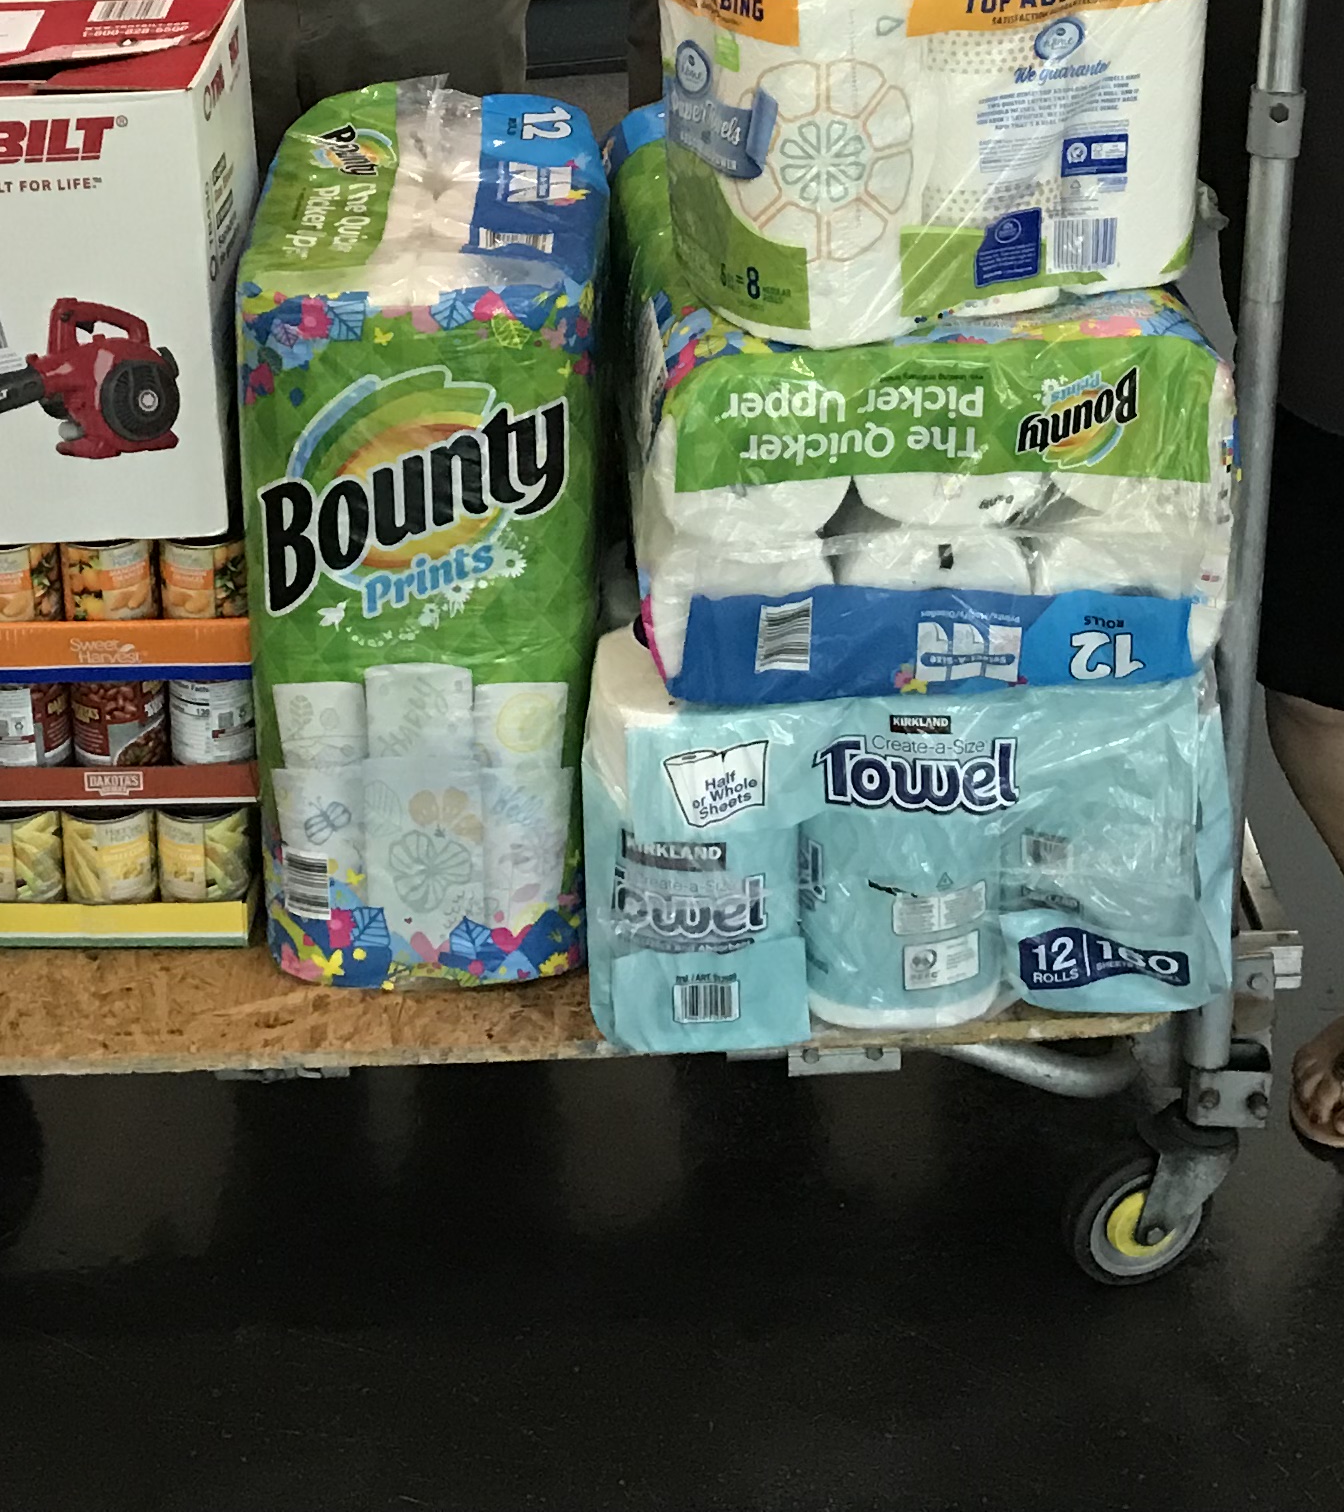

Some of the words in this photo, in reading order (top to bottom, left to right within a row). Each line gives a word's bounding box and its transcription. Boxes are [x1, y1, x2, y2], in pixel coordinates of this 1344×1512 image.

[1014, 65, 1036, 84] We
[520, 105, 572, 141] 12
[20, 179, 52, 193] FOR
[300, 185, 341, 229] Picker
[746, 266, 760, 299] 8
[721, 381, 846, 422] Upper
[857, 385, 984, 419] Picker
[1015, 366, 1139, 456] Bounty
[740, 422, 895, 466] Quicker
[909, 424, 979, 459] The
[258, 399, 567, 614] Bounty
[363, 544, 496, 615] Prints
[1083, 615, 1124, 630] ROLLS
[70, 639, 119, 652] Sweet
[79, 651, 142, 664] Harvest
[1068, 631, 1145, 680] 12
[893, 717, 949, 728] KIRKLAND
[872, 734, 985, 755] Create-a-Size
[90, 775, 139, 787] DAKOTA'S
[705, 769, 736, 792] Half
[816, 737, 1018, 810] Towel
[692, 796, 706, 809] or
[710, 777, 758, 802] Whole
[699, 792, 752, 820] Sheets
[1031, 936, 1077, 971] 12
[1032, 968, 1079, 984] ROLLS
